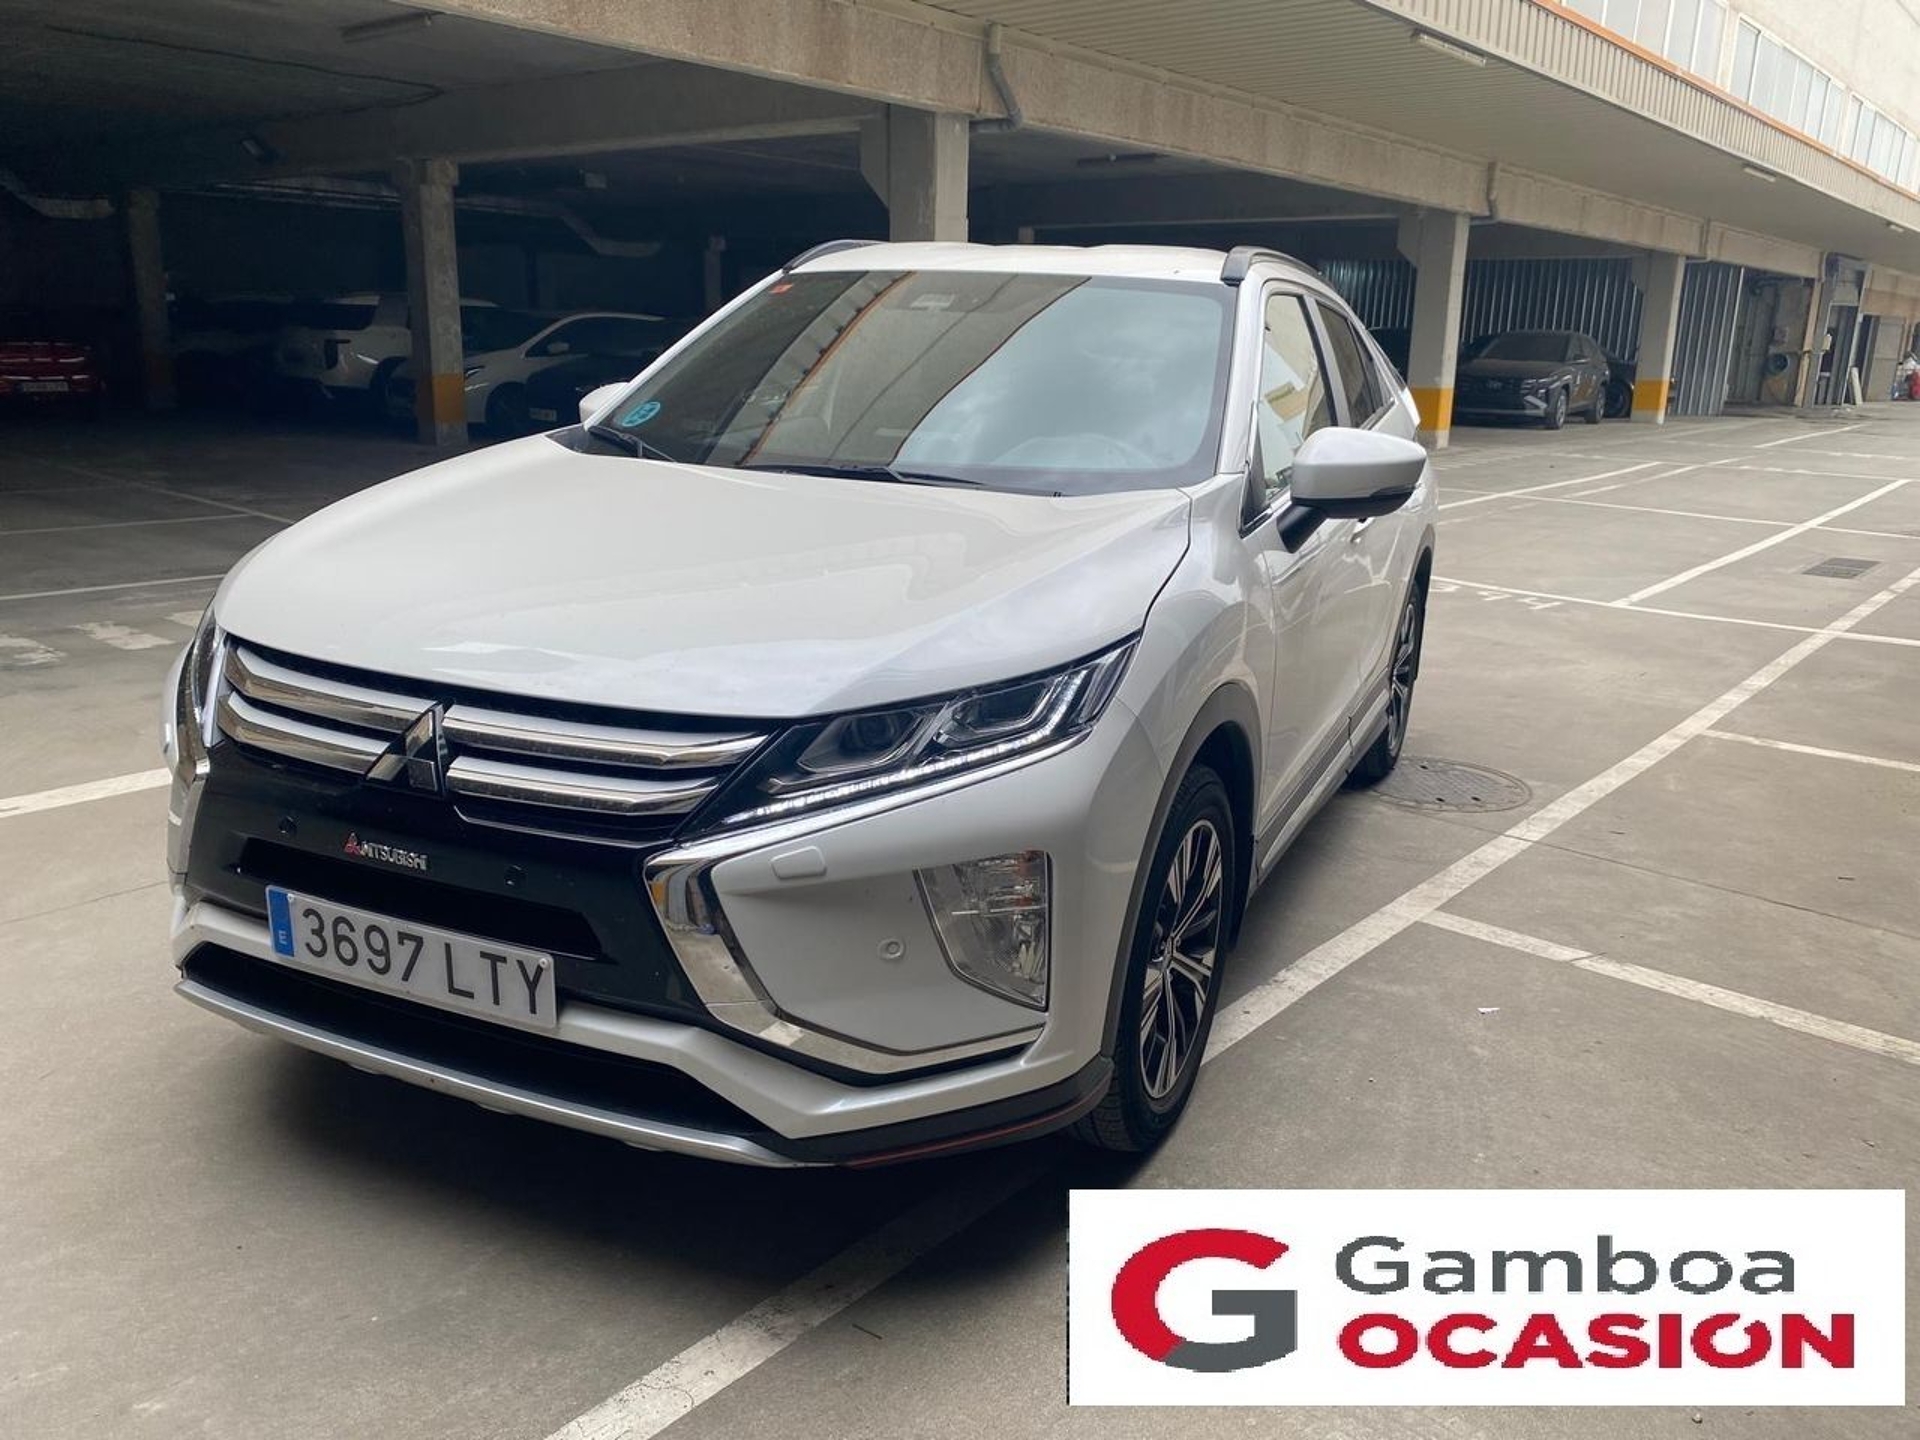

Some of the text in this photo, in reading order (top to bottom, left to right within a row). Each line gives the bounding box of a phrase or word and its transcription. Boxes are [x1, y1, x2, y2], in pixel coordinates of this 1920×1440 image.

[361, 841, 428, 870] MITSUBISHI
[278, 929, 288, 946] E
[302, 908, 544, 1015] 3697 LTY
